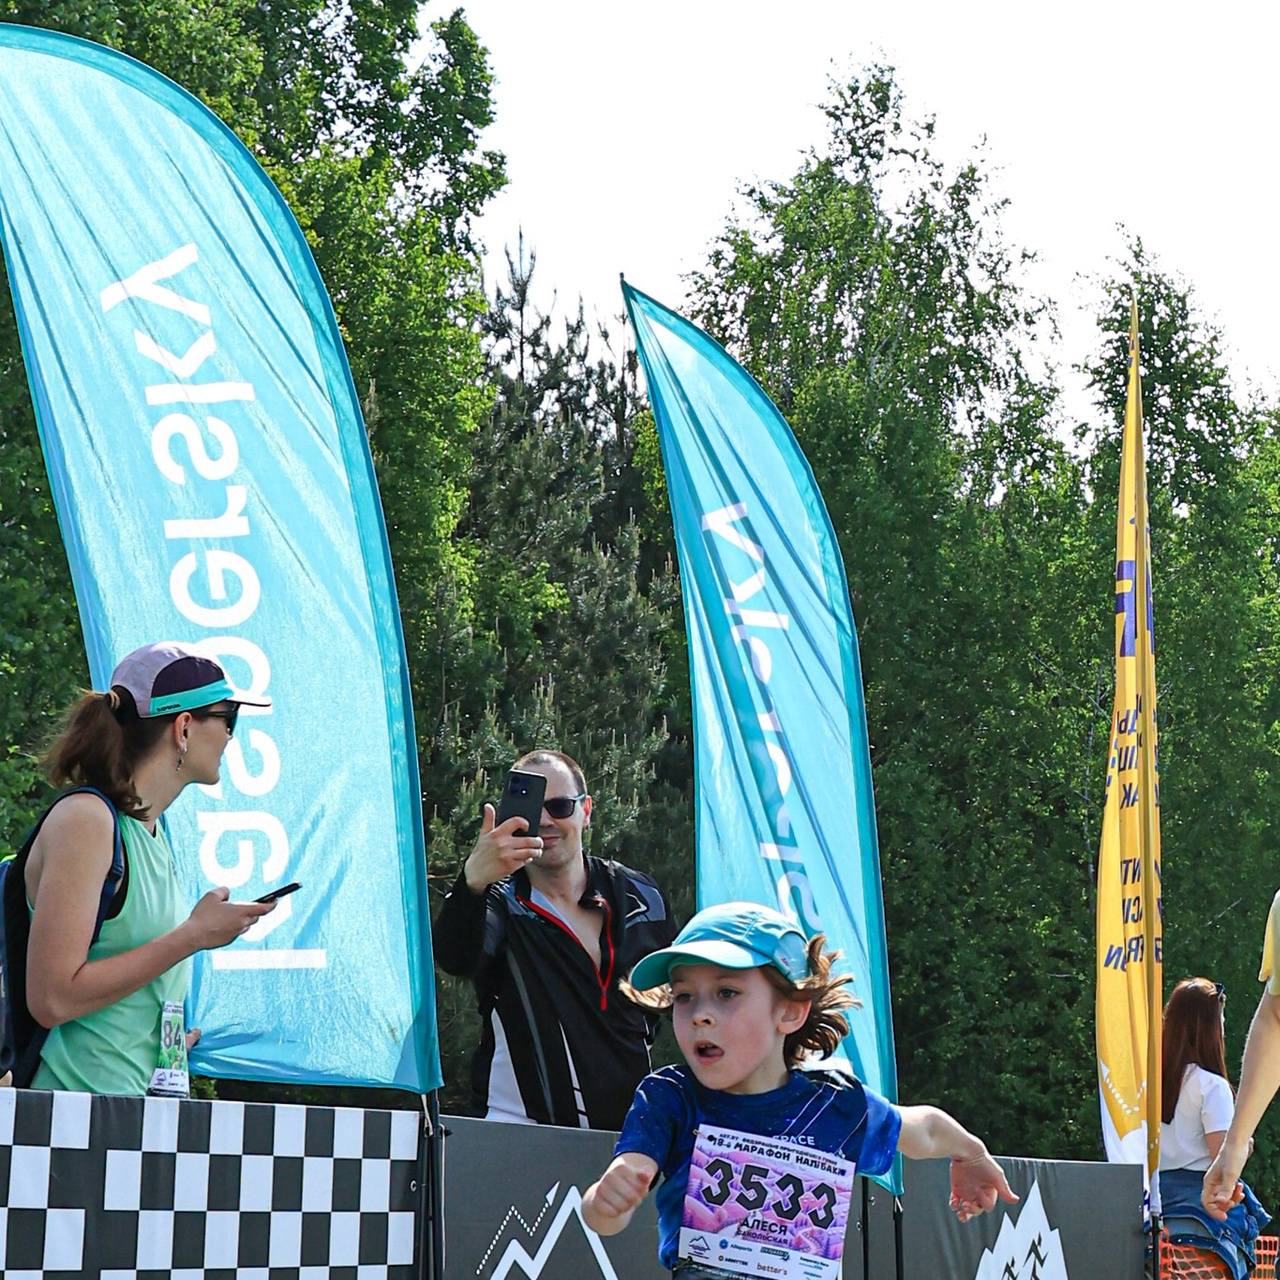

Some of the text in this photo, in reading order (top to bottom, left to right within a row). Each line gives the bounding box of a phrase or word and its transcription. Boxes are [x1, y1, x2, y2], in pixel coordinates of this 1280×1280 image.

[733, 1141, 791, 1162] МАРАФОН
[701, 1158, 837, 1229] 3533
[740, 1218, 788, 1236] АЛЕСЯ
[756, 1262, 788, 1276] better's
